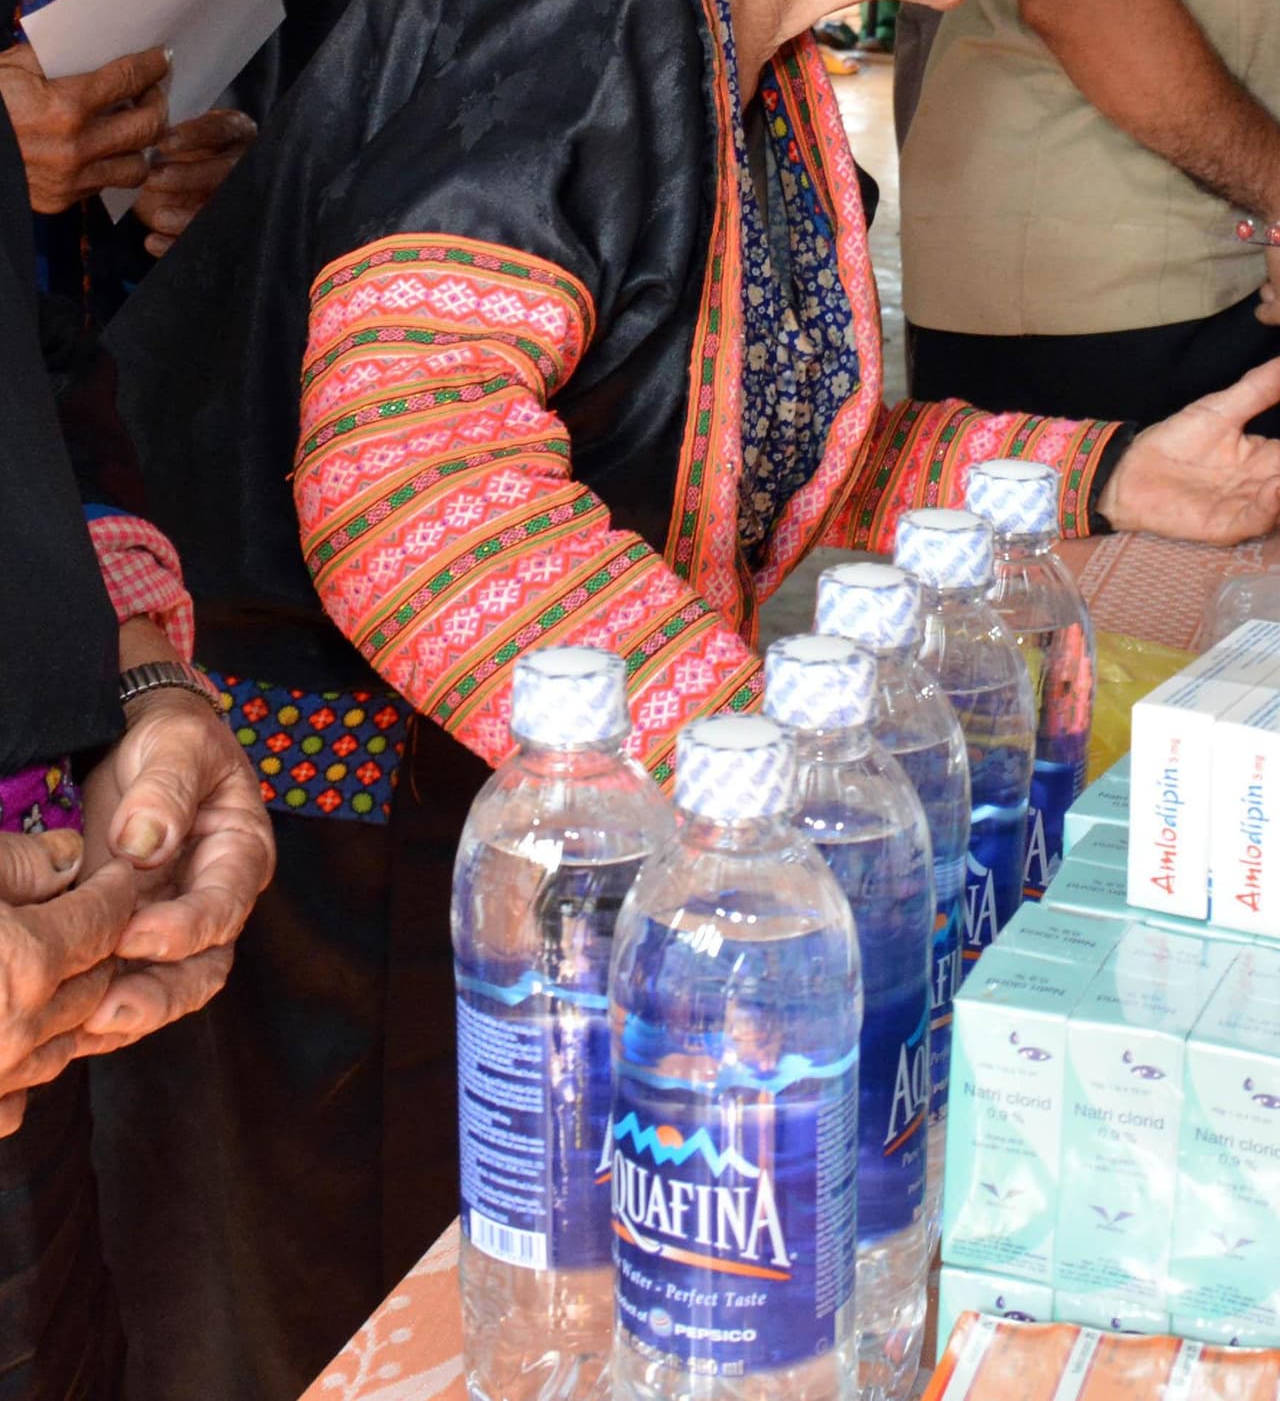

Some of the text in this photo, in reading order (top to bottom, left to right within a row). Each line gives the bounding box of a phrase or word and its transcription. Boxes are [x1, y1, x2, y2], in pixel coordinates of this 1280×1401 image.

[1150, 767, 1185, 895] Amlodipin
[1235, 784, 1270, 913] Amlodipin
[962, 1081, 1053, 1111] Natri clorid
[1073, 1101, 1166, 1131] Natri clorid
[1194, 1126, 1236, 1150] Natri
[611, 1147, 793, 1268] QUAFINA
[666, 1283, 719, 1308] Perfect
[724, 1290, 769, 1308] Taste
[674, 1323, 757, 1343] PEPSICO
